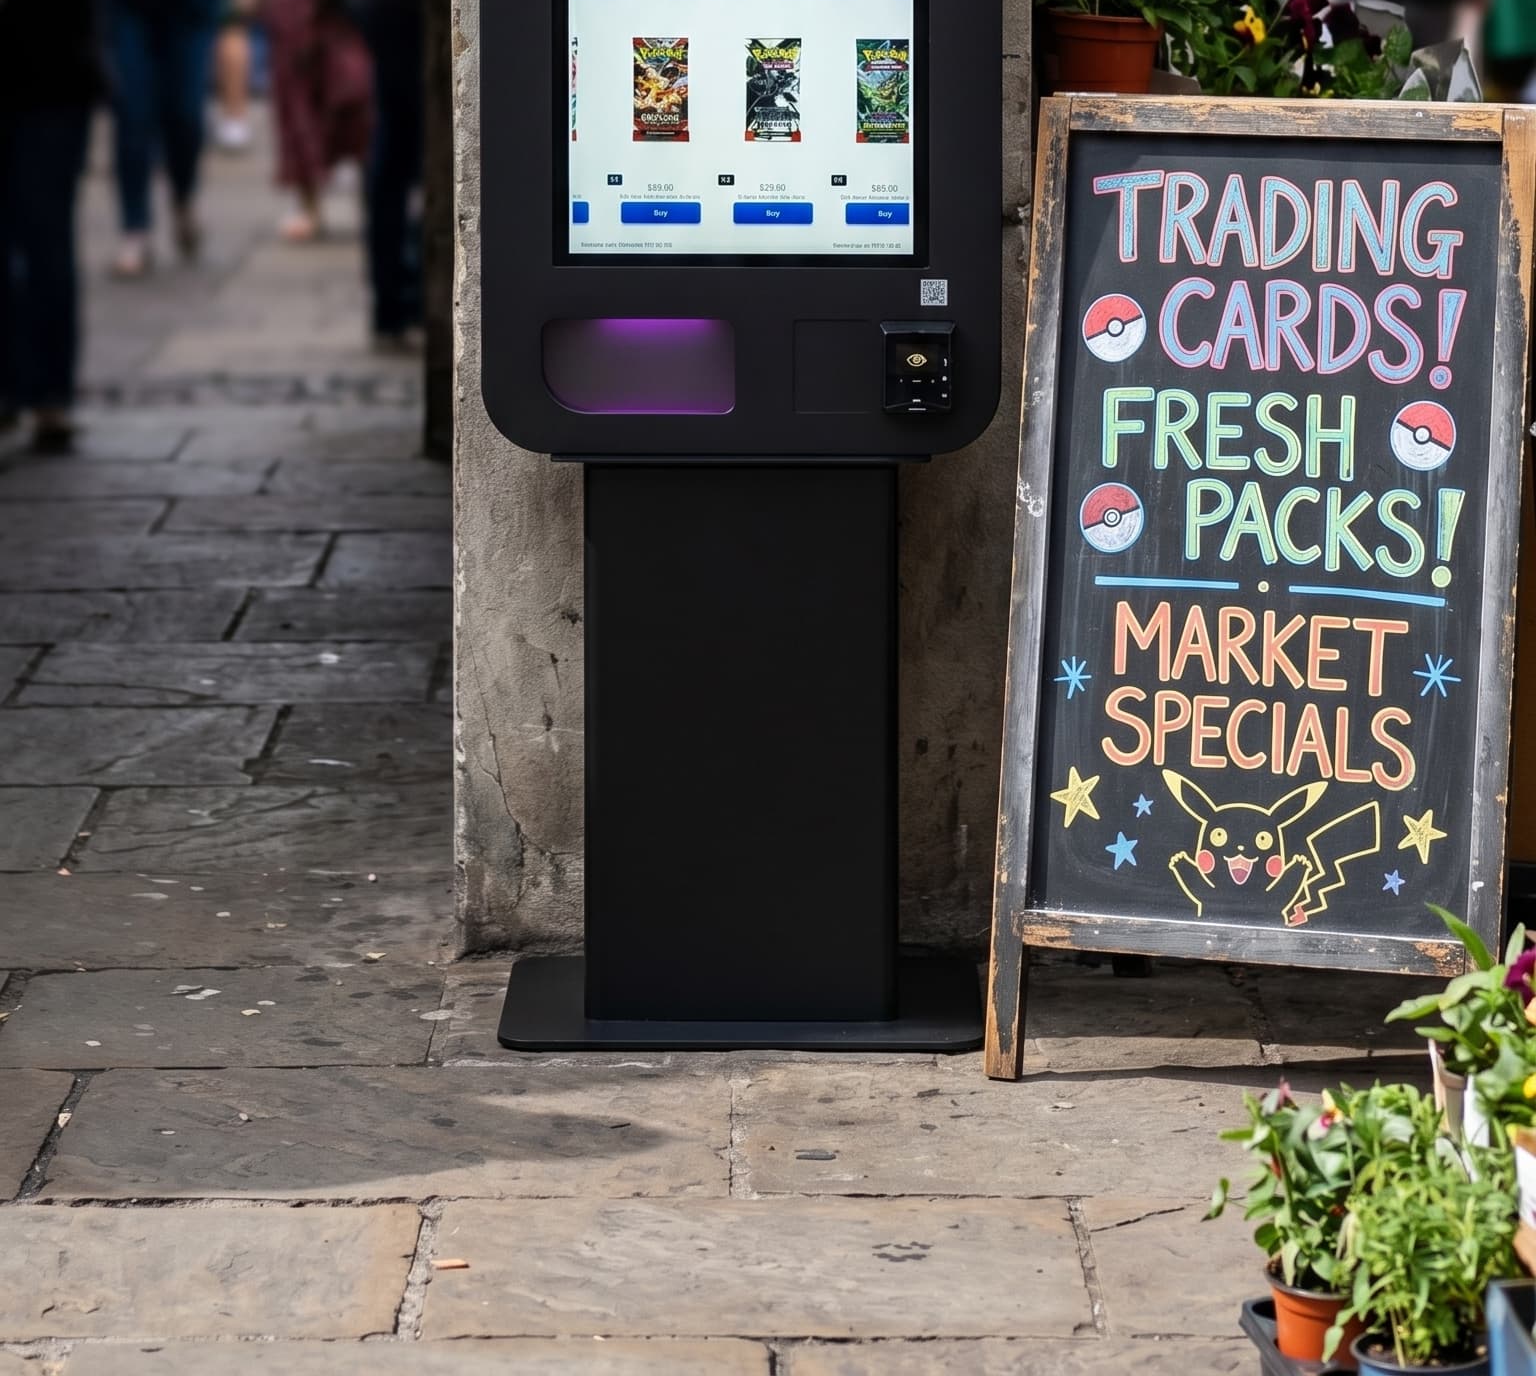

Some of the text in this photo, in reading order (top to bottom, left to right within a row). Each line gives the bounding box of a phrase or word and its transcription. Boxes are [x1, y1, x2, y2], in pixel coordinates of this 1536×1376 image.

[1093, 169, 1464, 280] TRADING
[1158, 276, 1468, 390] CARDS!
[1102, 386, 1357, 482] FRESH
[1185, 477, 1466, 589] PACKS!
[1113, 600, 1409, 698] MARKET
[1101, 685, 1417, 792] SPECIALS
